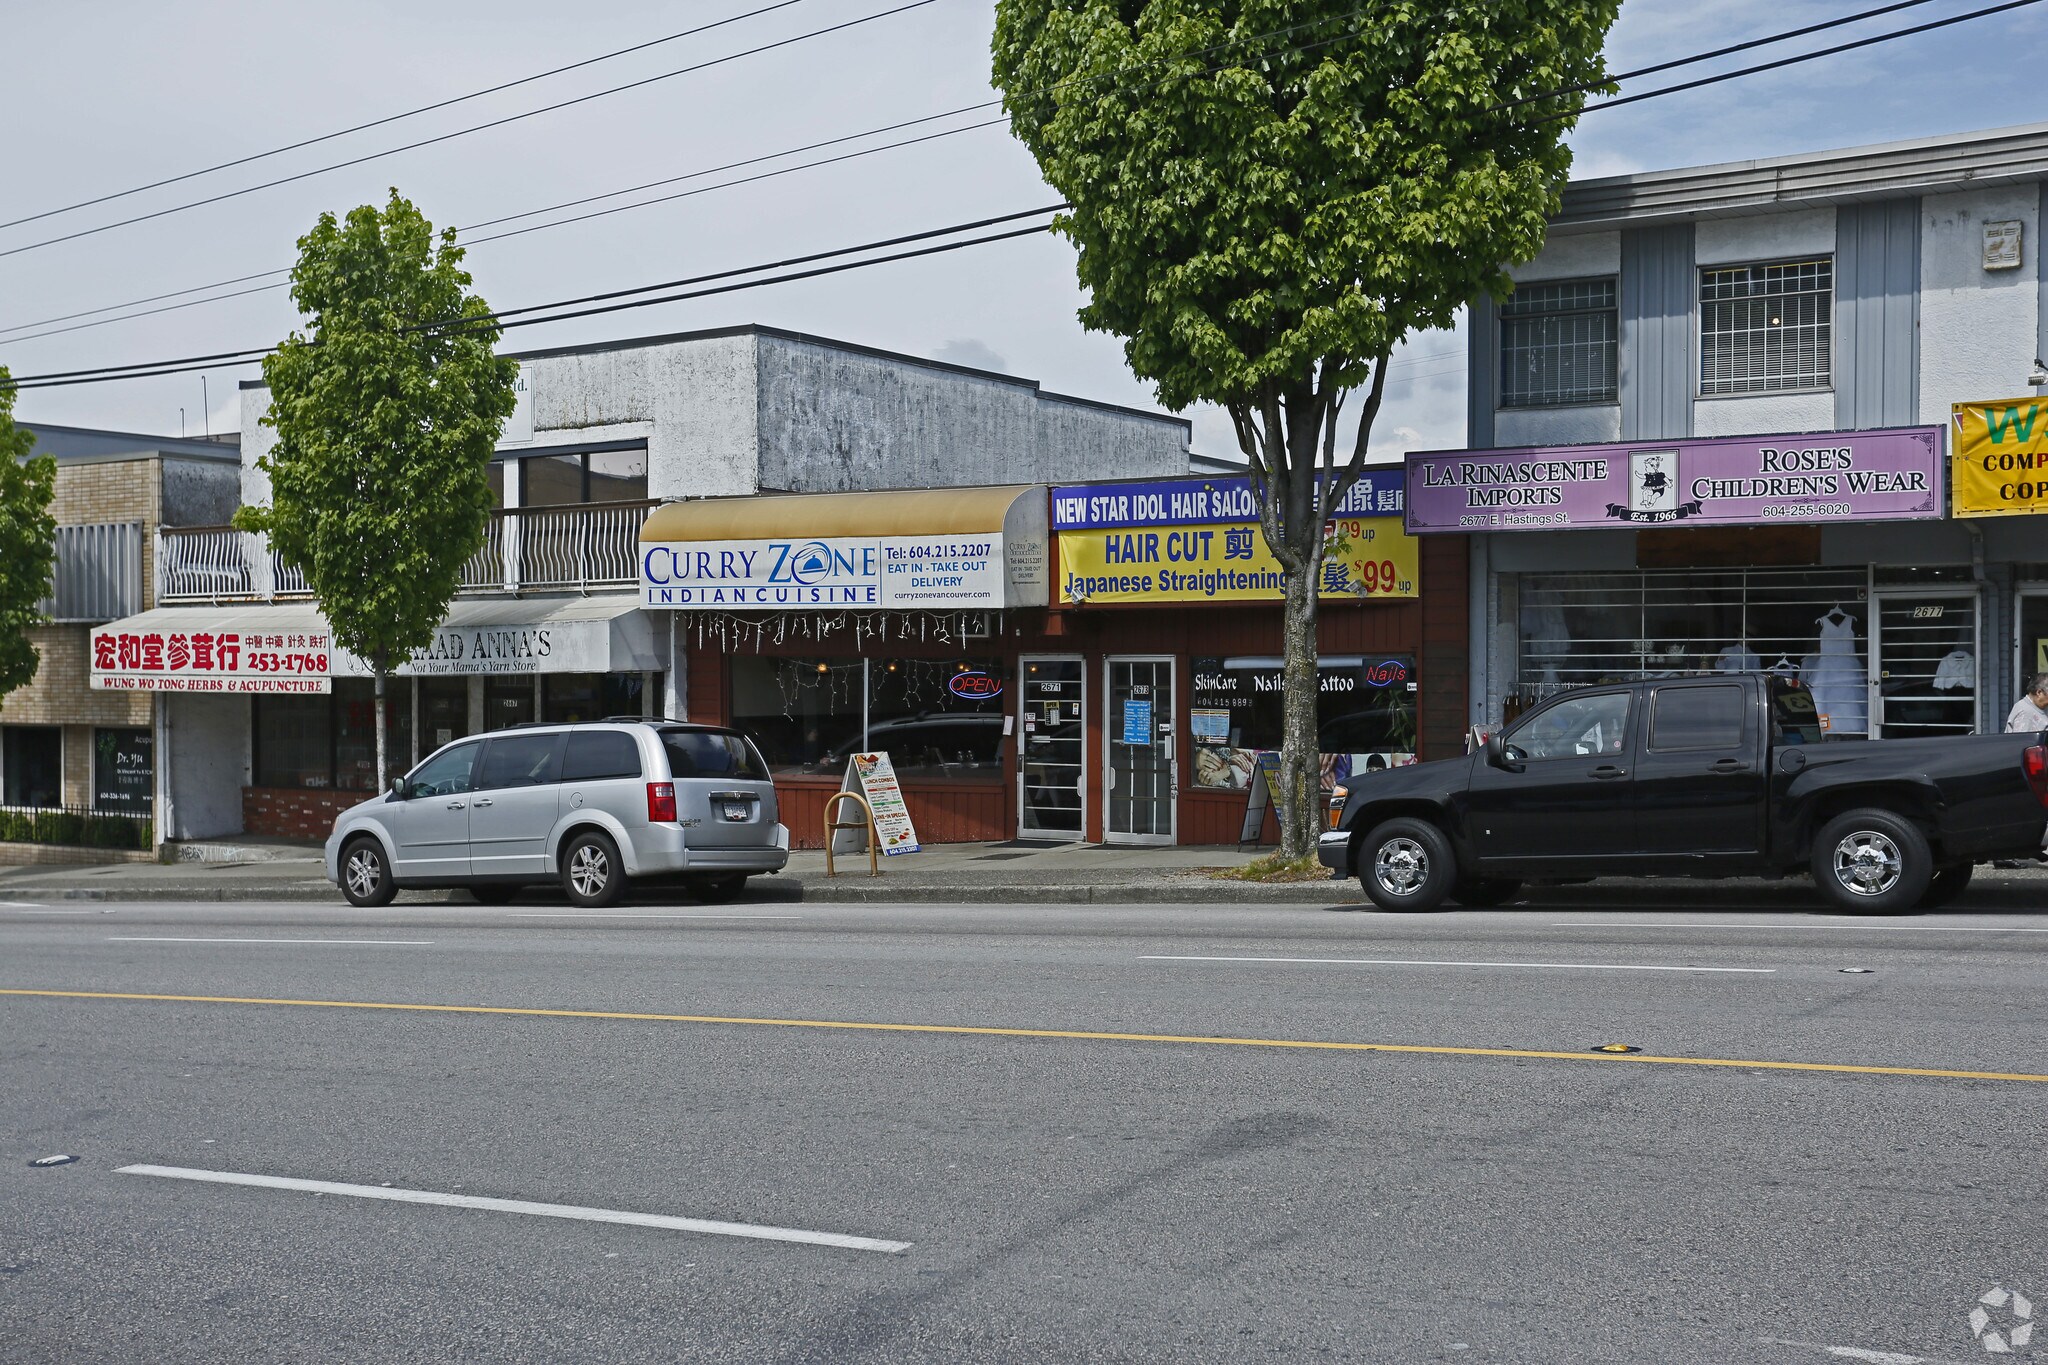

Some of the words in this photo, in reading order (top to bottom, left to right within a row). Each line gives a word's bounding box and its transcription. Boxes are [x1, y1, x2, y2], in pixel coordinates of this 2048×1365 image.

[513, 379, 528, 391] td.
[1760, 448, 1852, 472] ROSE'S
[1424, 465, 1455, 486] LA
[1460, 460, 1607, 484] RINASCENTE
[1691, 475, 1837, 499] CHILDREN'S
[1844, 472, 1928, 493] WEAR
[1467, 487, 1561, 507] IMPORTS
[1056, 498, 1087, 523] NEW
[1091, 495, 1129, 522] STAR
[1133, 493, 1167, 520] IDOL
[1171, 492, 1207, 519] HAIR
[1763, 504, 1850, 517] 604-255-6020
[1460, 515, 1488, 526] 2677
[1490, 515, 1501, 525] E.
[1504, 513, 1552, 527] Hastings
[1555, 513, 1570, 523] St.
[1630, 511, 1650, 522] Est.
[1653, 510, 1677, 521] 1966
[1362, 529, 1375, 542] up
[885, 547, 906, 559] Tel:
[909, 544, 991, 558] 604.215.2207
[1105, 533, 1159, 564] HAIR
[1167, 531, 1214, 562] CUT
[644, 546, 758, 585] CURRY
[767, 541, 877, 585] ZONE
[888, 563, 908, 573] EAT
[911, 563, 923, 573] IN
[931, 562, 958, 572] TAKE
[962, 561, 987, 571] OUT
[912, 576, 963, 587] DELIVERY
[1064, 572, 1152, 598] Japanese
[1318, 562, 1351, 594] 髮
[1399, 580, 1411, 593] up
[894, 590, 991, 601] curryzonevancouver.com
[1914, 606, 1943, 617] 2677
[472, 630, 551, 659] ANNA'S
[248, 652, 328, 674] 253-1768
[411, 662, 426, 673] Not
[429, 662, 449, 673] Your
[450, 661, 487, 672] Mama's
[488, 661, 510, 672] Yarn
[512, 660, 536, 671] Store
[1366, 666, 1406, 681] Nails
[103, 677, 135, 689] WUNG
[138, 678, 154, 689] WO
[158, 679, 185, 690] TONG
[187, 679, 223, 690] HERBS
[228, 680, 237, 690] &
[239, 680, 322, 692] ACUPUNCTURE
[951, 676, 1001, 692] OPEN
[1042, 683, 1060, 691] 2671
[1195, 673, 1237, 690] SkinCare
[1317, 673, 1354, 692] attoo
